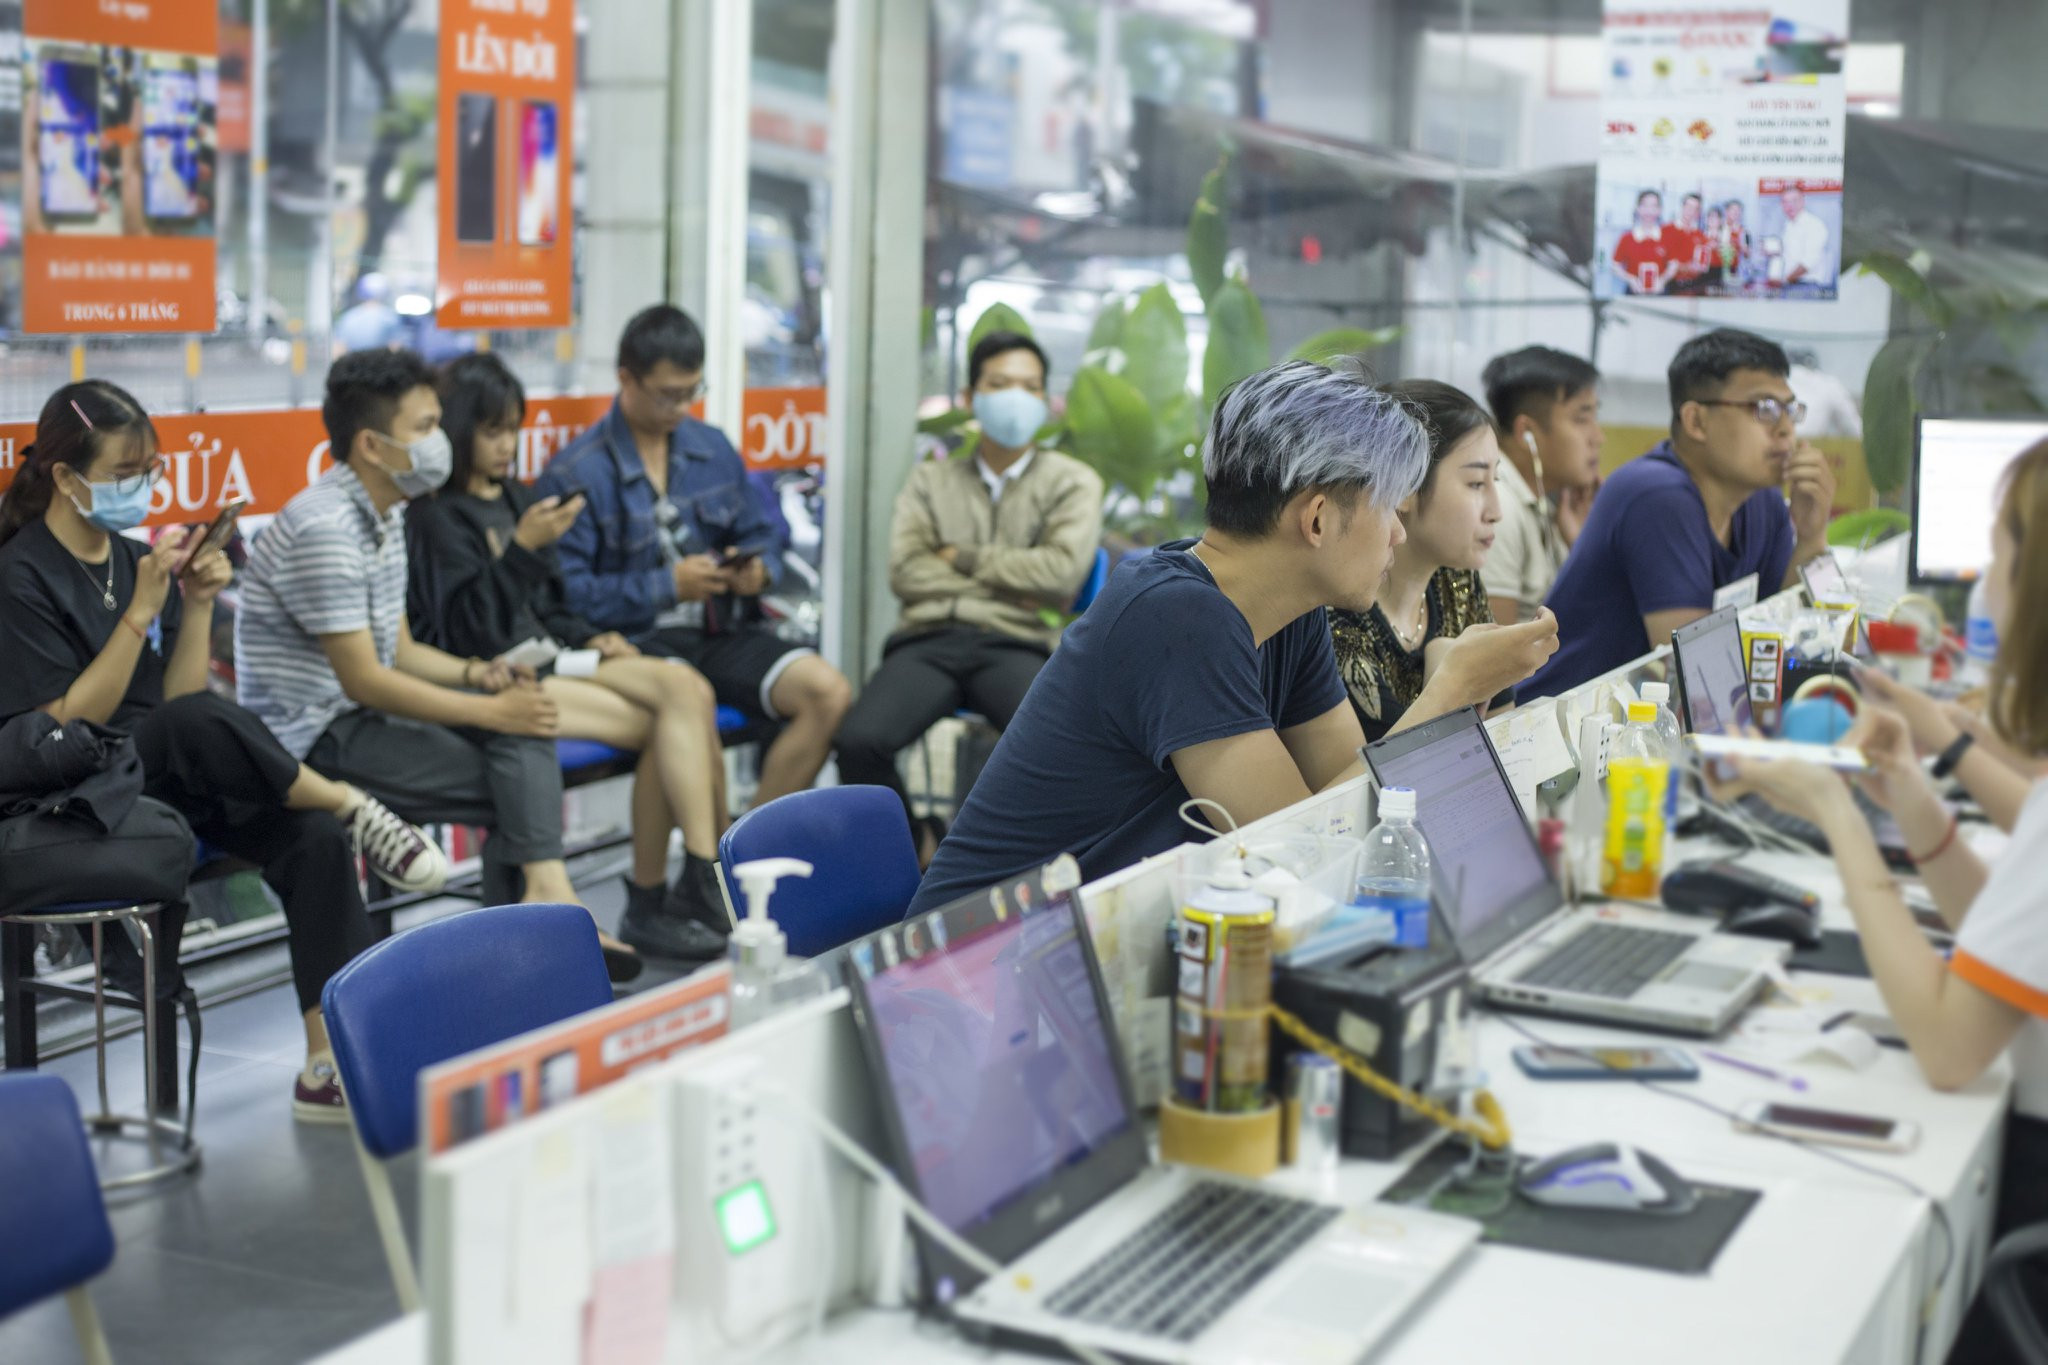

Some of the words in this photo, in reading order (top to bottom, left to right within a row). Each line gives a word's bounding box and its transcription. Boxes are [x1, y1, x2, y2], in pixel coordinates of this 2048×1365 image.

[64, 302, 114, 321] TRONG
[117, 304, 126, 320] 6
[130, 298, 179, 321] THÁNG
